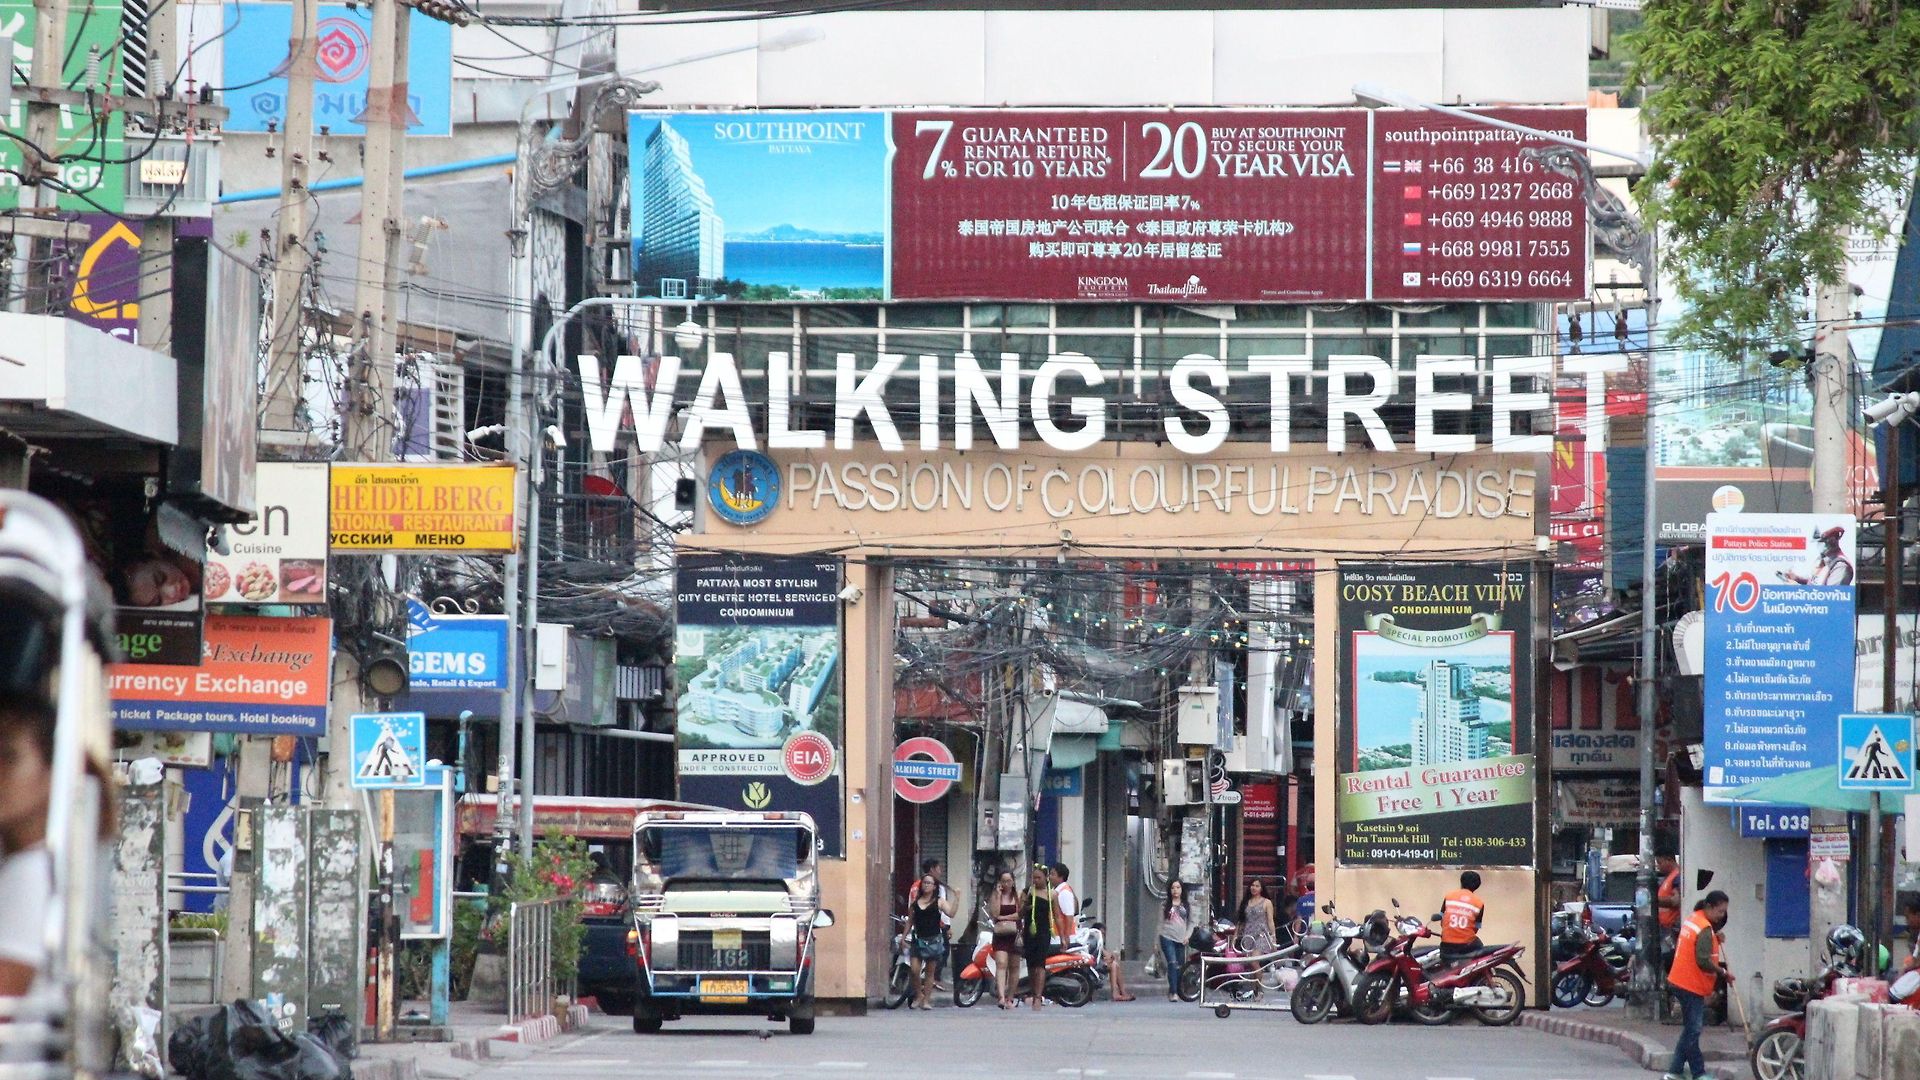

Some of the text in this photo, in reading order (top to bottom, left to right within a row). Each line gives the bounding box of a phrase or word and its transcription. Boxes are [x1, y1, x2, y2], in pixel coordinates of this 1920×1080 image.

[714, 122, 866, 140] SOUTHPOINT
[962, 127, 1108, 143] GUARANTEED
[1212, 127, 1346, 138] BUY AT SOUTHPOINT
[1385, 127, 1574, 145] southpointpattaya.m
[964, 145, 1107, 159] RENTAL RETURN
[1139, 121, 1208, 178] 20
[1211, 140, 1345, 151] TO SECURE YOUR
[964, 160, 1009, 177] FOR
[1012, 160, 1035, 177] 10
[1212, 153, 1355, 177] YEAR VISA
[1429, 157, 1533, 174] +66 38 416
[1427, 183, 1573, 200] +669 1237 2668
[1427, 211, 1573, 228] +669 4946 9888
[1427, 240, 1570, 257] +668 9981 7555
[1848, 239, 1890, 249] RDEN
[1078, 276, 1128, 286] KINGDOM
[1427, 270, 1573, 287] +669 6319 6664
[577, 351, 1629, 454] WALKING STREET
[787, 461, 1537, 519] PASSION OF COLOURFUL PARADISE
[334, 485, 503, 512] HEIDELBERG
[403, 513, 506, 531] RESTAURANT
[1662, 522, 1706, 531] GLOBA
[331, 530, 465, 545] УССКИЙ МЕНЮ
[1723, 540, 1793, 548] Pattaya Police Station
[233, 543, 282, 554] Cuisine
[696, 579, 818, 588] PATTAYA MOST STYLISH
[678, 593, 836, 602] CITY CENTRE HOTEL SERVICED
[1343, 584, 1525, 602] COSY BEACH VIEW
[1711, 571, 1760, 613] 10
[720, 608, 794, 617] CONDOMINIUM
[1392, 605, 1472, 614] CONDOMINIUM
[1386, 628, 1482, 644] SPECIAL PROMOTION
[212, 643, 314, 670] Exchange
[409, 650, 486, 675] GEMS
[195, 672, 308, 699] Exchange
[467, 679, 497, 688] Export
[120, 709, 151, 719] ticket
[156, 711, 203, 723] Package
[240, 713, 269, 723] Hotel
[271, 714, 316, 727] booking
[691, 753, 766, 762] APPROVED
[793, 751, 823, 765] EIA
[712, 764, 779, 772] CONSTRUCTION
[894, 765, 957, 776] ALKING STREET
[1347, 761, 1526, 795] Rental Guarantee
[1376, 786, 1500, 815] Free 1 Year
[1356, 823, 1419, 833] Kasetsin 9 soi
[1748, 815, 1810, 831] Tel. 038
[1346, 834, 1430, 844] Phra Tamnak Hill
[1465, 836, 1526, 847] 038-306-433
[1371, 849, 1434, 859] 091-01-419-01
[1449, 914, 1468, 929] 30
